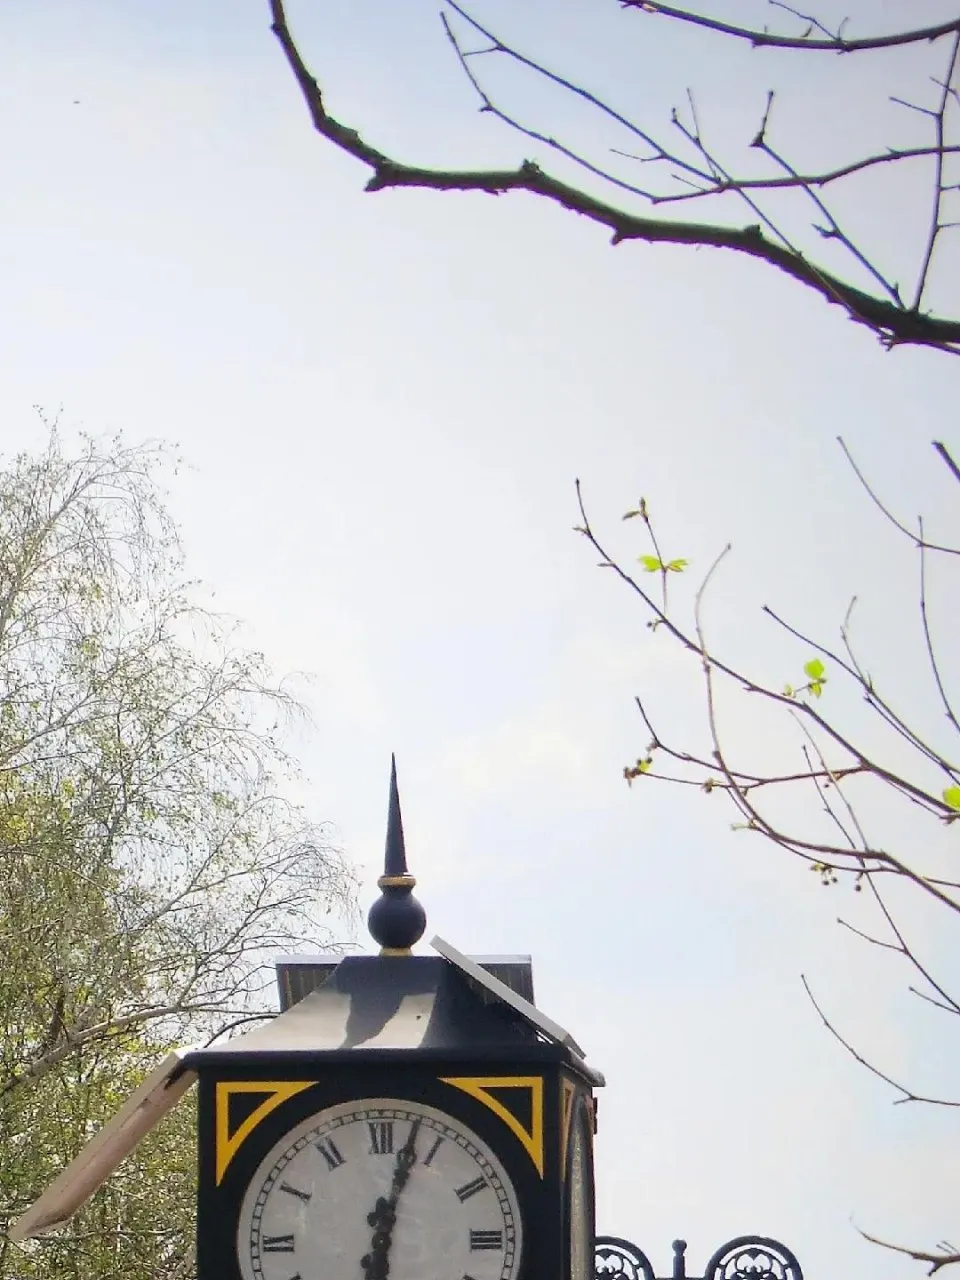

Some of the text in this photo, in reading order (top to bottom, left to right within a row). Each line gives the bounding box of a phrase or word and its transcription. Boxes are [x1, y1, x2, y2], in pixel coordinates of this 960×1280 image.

[367, 1121, 395, 1155] XII
[423, 1135, 446, 1167] I
[453, 1176, 488, 1203] II
[263, 1234, 295, 1253] IX
[469, 1228, 502, 1252] III
